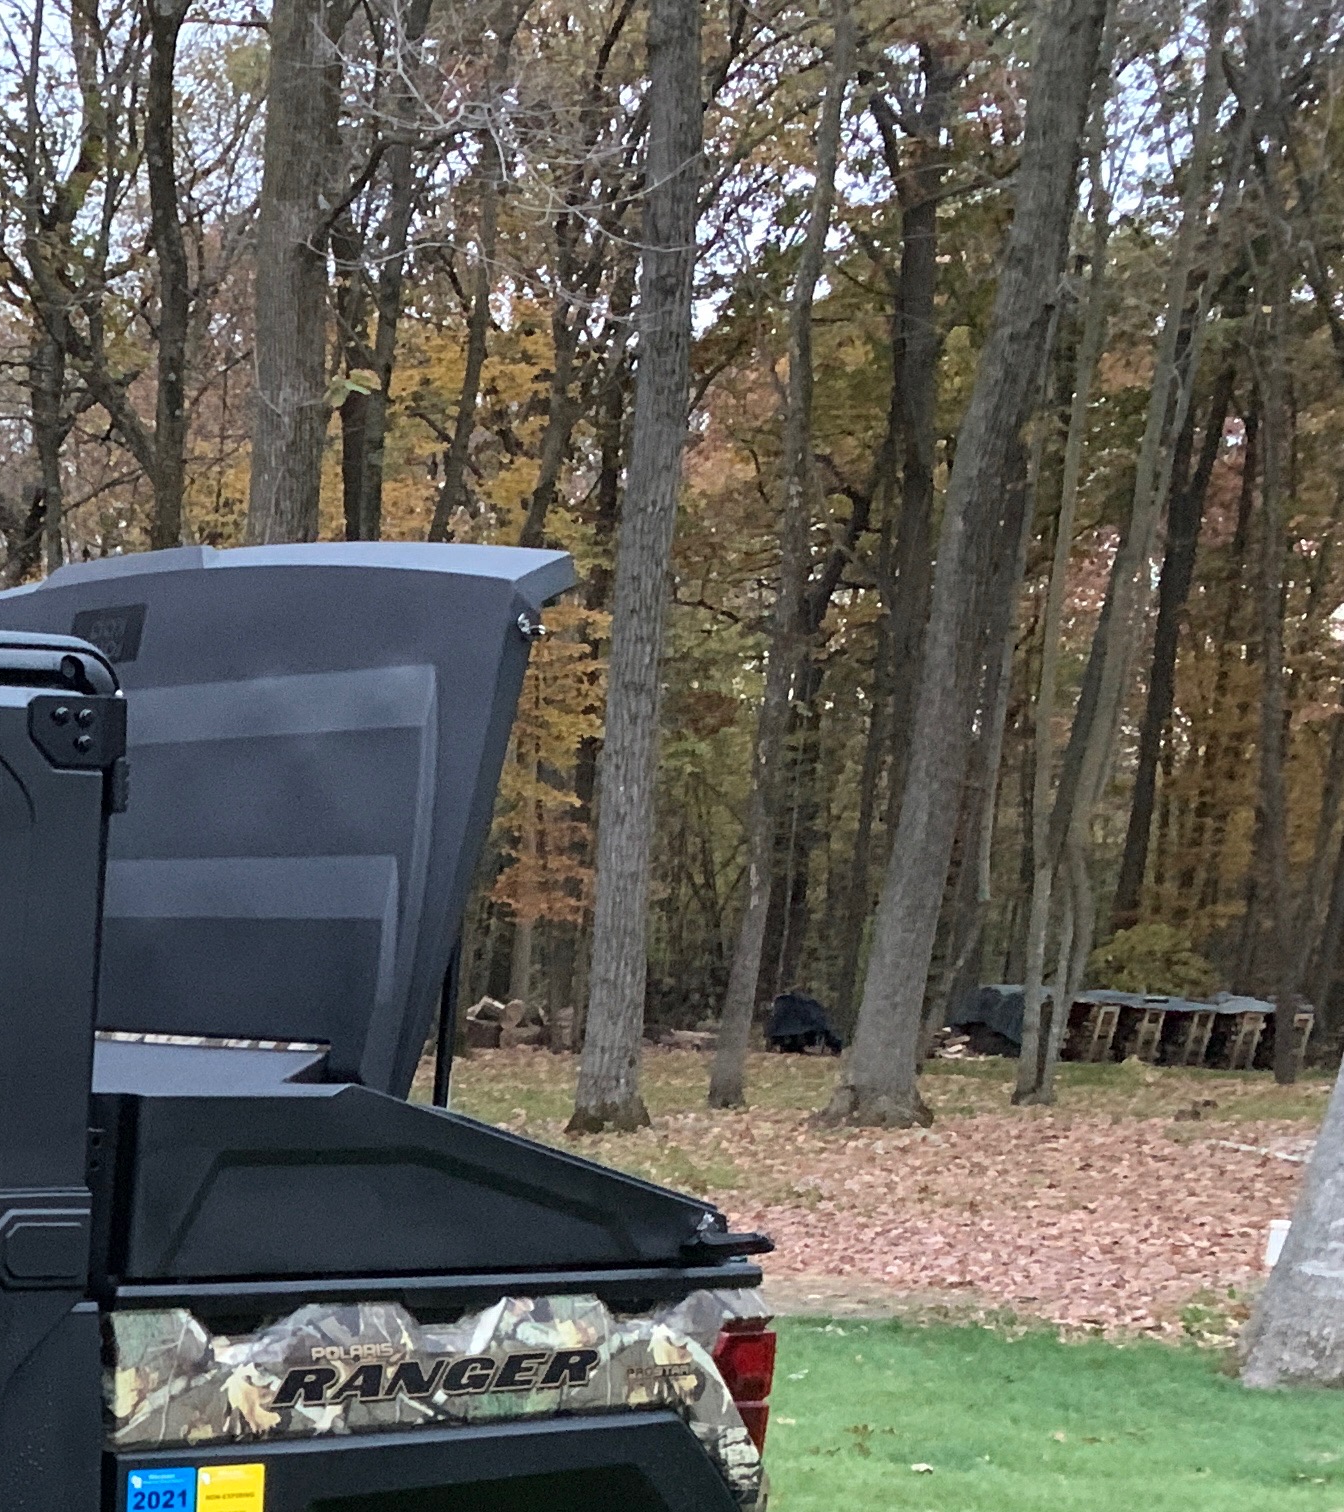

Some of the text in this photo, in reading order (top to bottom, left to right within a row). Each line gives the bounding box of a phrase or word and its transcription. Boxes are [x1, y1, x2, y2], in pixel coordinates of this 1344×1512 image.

[312, 1342, 394, 1361] POLARIS
[270, 1347, 601, 1409] RANGER
[133, 1488, 187, 1510] 2021
